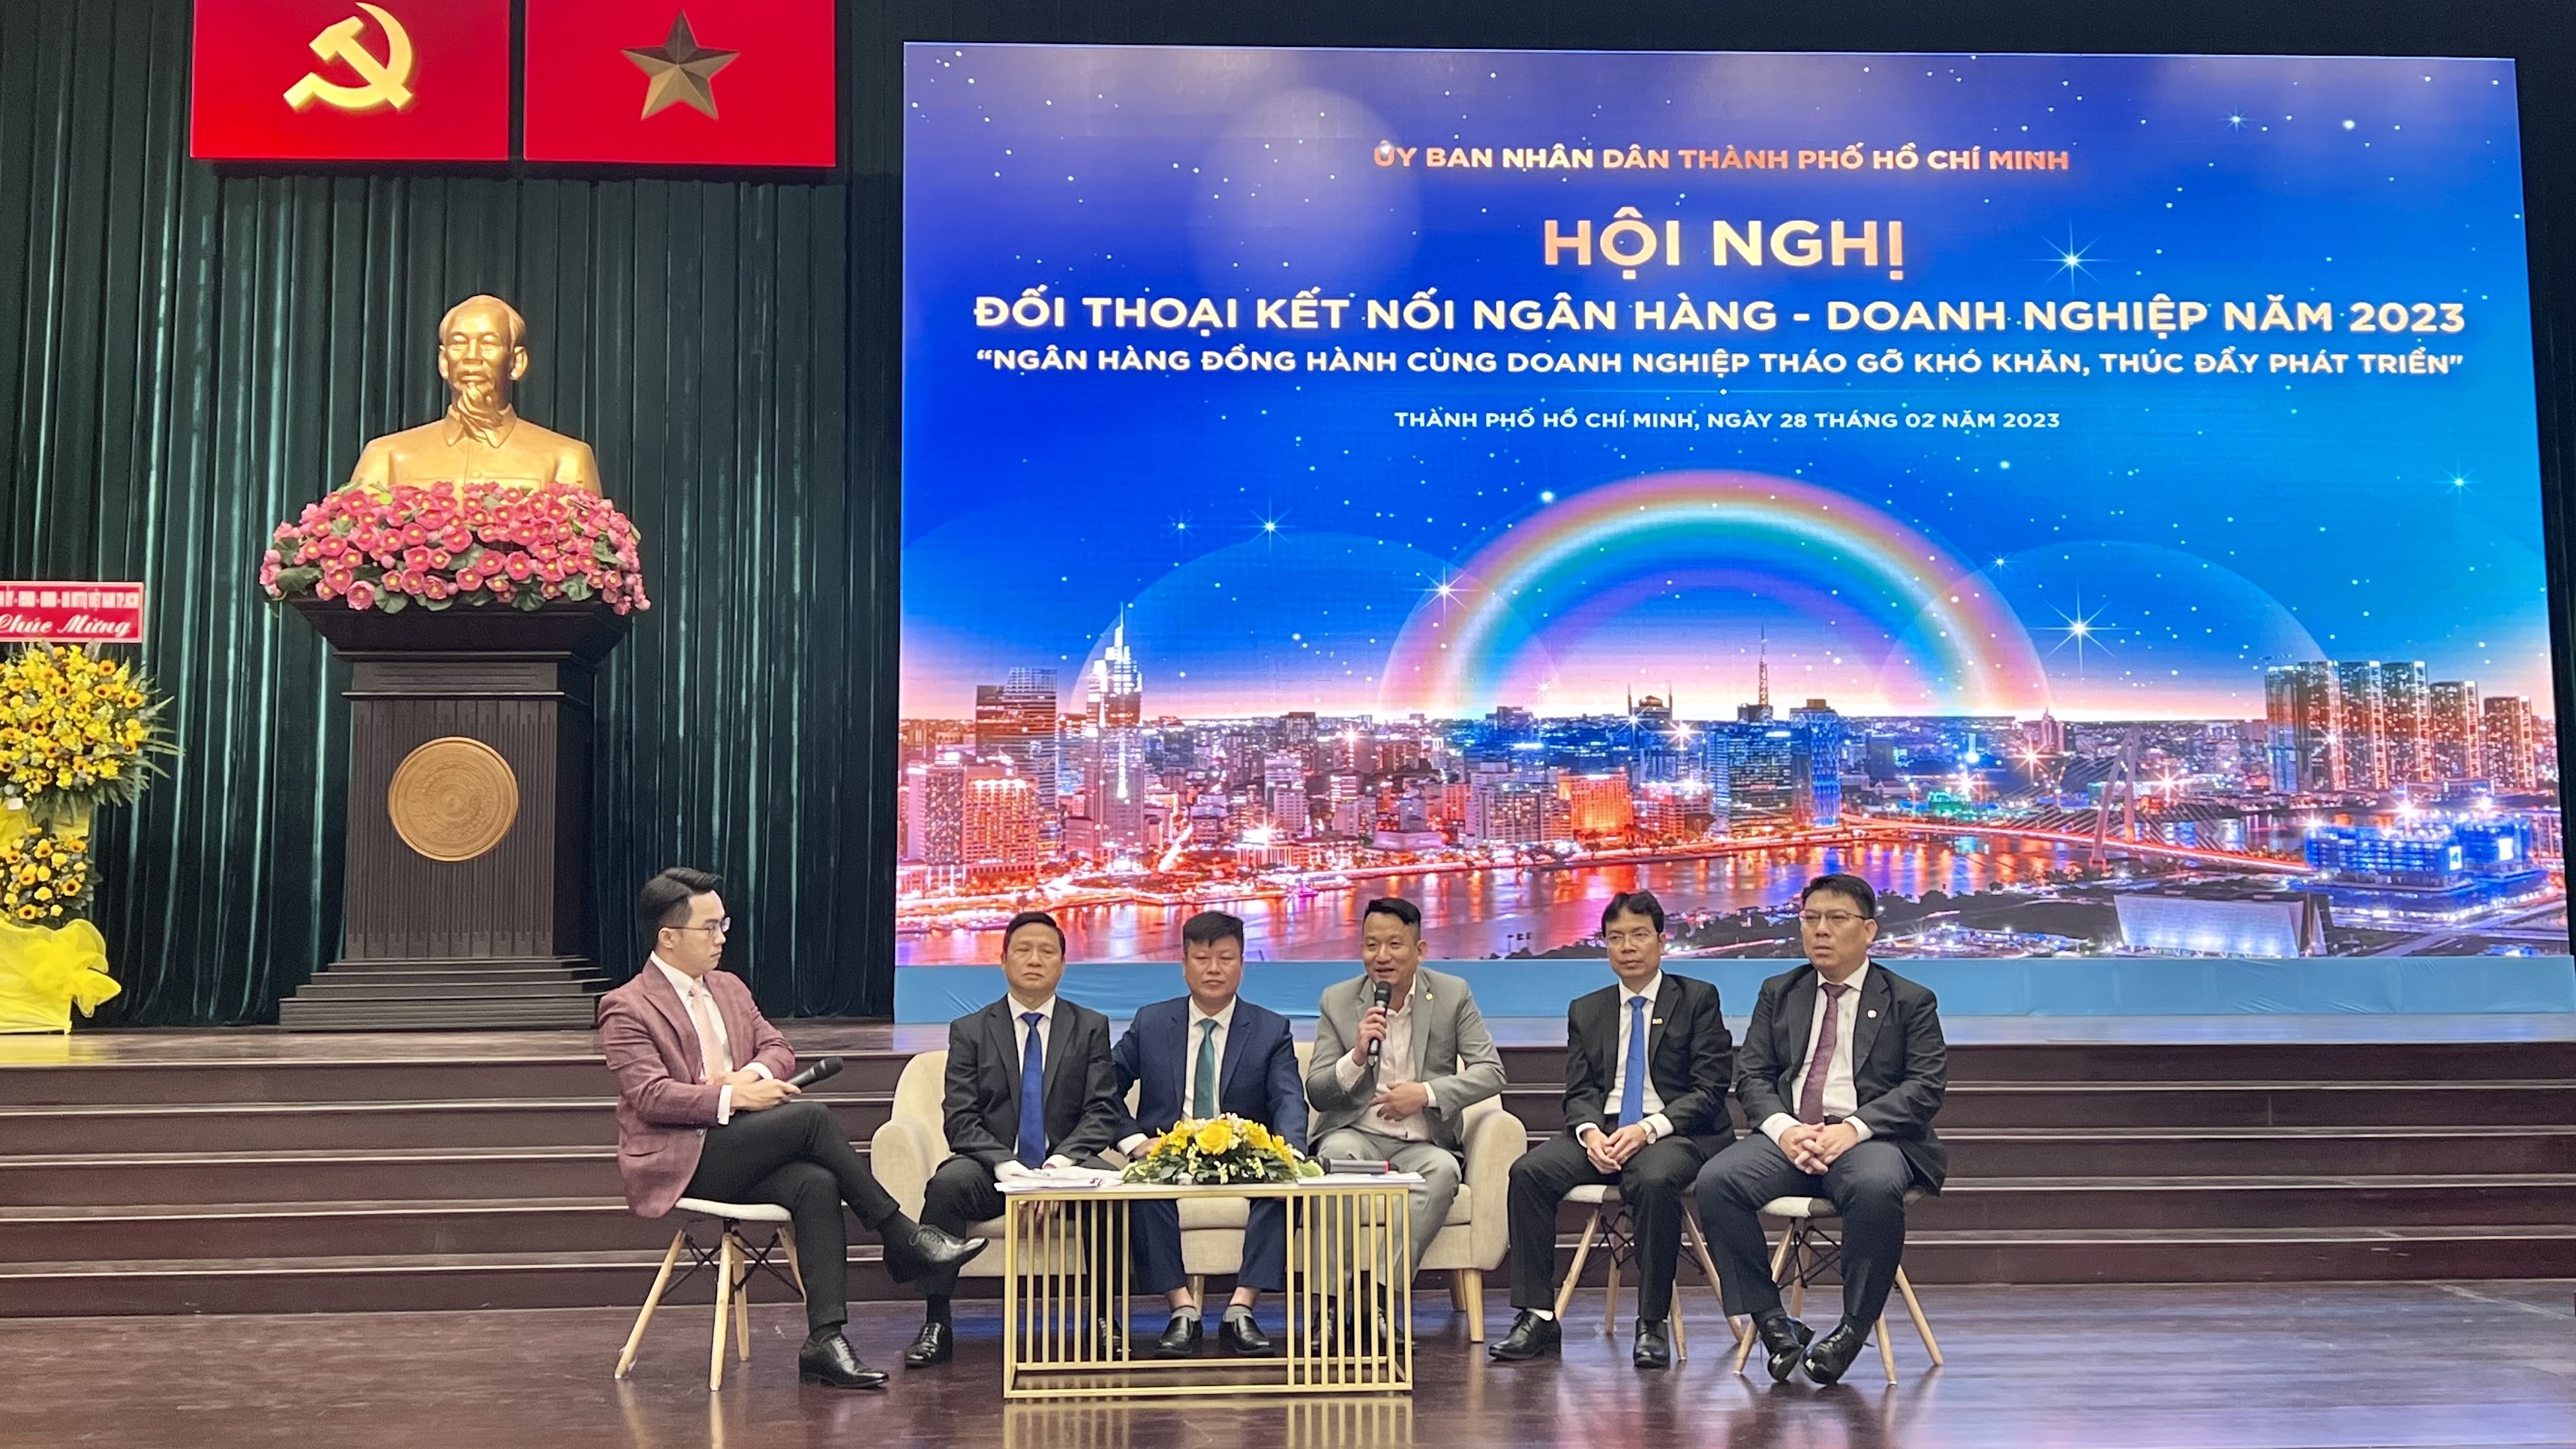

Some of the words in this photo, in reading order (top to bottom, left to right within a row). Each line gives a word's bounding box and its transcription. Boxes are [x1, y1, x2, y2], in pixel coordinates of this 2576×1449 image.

[1373, 139, 1417, 168] ỦY
[1426, 147, 1493, 168] BAN
[1502, 143, 1594, 169] NHÂN
[1603, 144, 1670, 169] DÂN
[1677, 143, 1789, 169] THÀNH
[1797, 141, 1865, 170] PHỐ
[1872, 141, 1919, 170] HỒ
[1926, 144, 1981, 170] CHÍ
[1989, 150, 2069, 170] MINH
[1544, 206, 1680, 281] HỘI
[1712, 220, 1904, 281] NGHỊ
[973, 284, 1065, 327] ĐỐI
[1082, 297, 1237, 337] THOẠI
[1257, 286, 1350, 329] KẾT
[1367, 286, 1454, 330] NỐI
[1474, 291, 1616, 331] NGÂN
[1635, 291, 1776, 331] HÀNG
[1793, 313, 1810, 322] -
[1827, 300, 2005, 331] DOANH
[2024, 293, 2208, 339] NGHIỆP
[2224, 293, 2333, 332] NĂM
[2350, 302, 2465, 333] 2023
[976, 344, 1087, 370] “NGÂN
[1098, 345, 1190, 371] HÀNG
[1200, 344, 1296, 371] ĐỒNG
[1307, 346, 1396, 371] HÀNH
[1407, 346, 1496, 372] CÙNG
[1507, 352, 1622, 372] DOANH
[1633, 348, 1750, 378] NGHIỆP
[1759, 348, 1847, 373] THÁO
[1857, 348, 1904, 373] GỠ
[1915, 348, 1982, 373] KHÓ
[1992, 348, 2090, 377] KHĂN,
[2099, 348, 2183, 373] THÚC
[2194, 346, 2259, 373] ĐẨY
[2270, 349, 2349, 374] PHÁT
[1395, 407, 1477, 427] THÀNH
[1485, 406, 1535, 428] PHỐ
[1543, 406, 1578, 428] HỒ
[1585, 408, 1627, 428] CHÍ
[1633, 412, 1699, 431] MINH,
[1708, 407, 1773, 428] NGÀY
[1781, 412, 1807, 428] 28
[1814, 407, 1898, 428] THÁNG
[1905, 412, 1936, 428] 02
[1942, 407, 1995, 428] NĂM
[2003, 412, 2060, 428] 2023
[56, 614, 131, 638] Mừng
